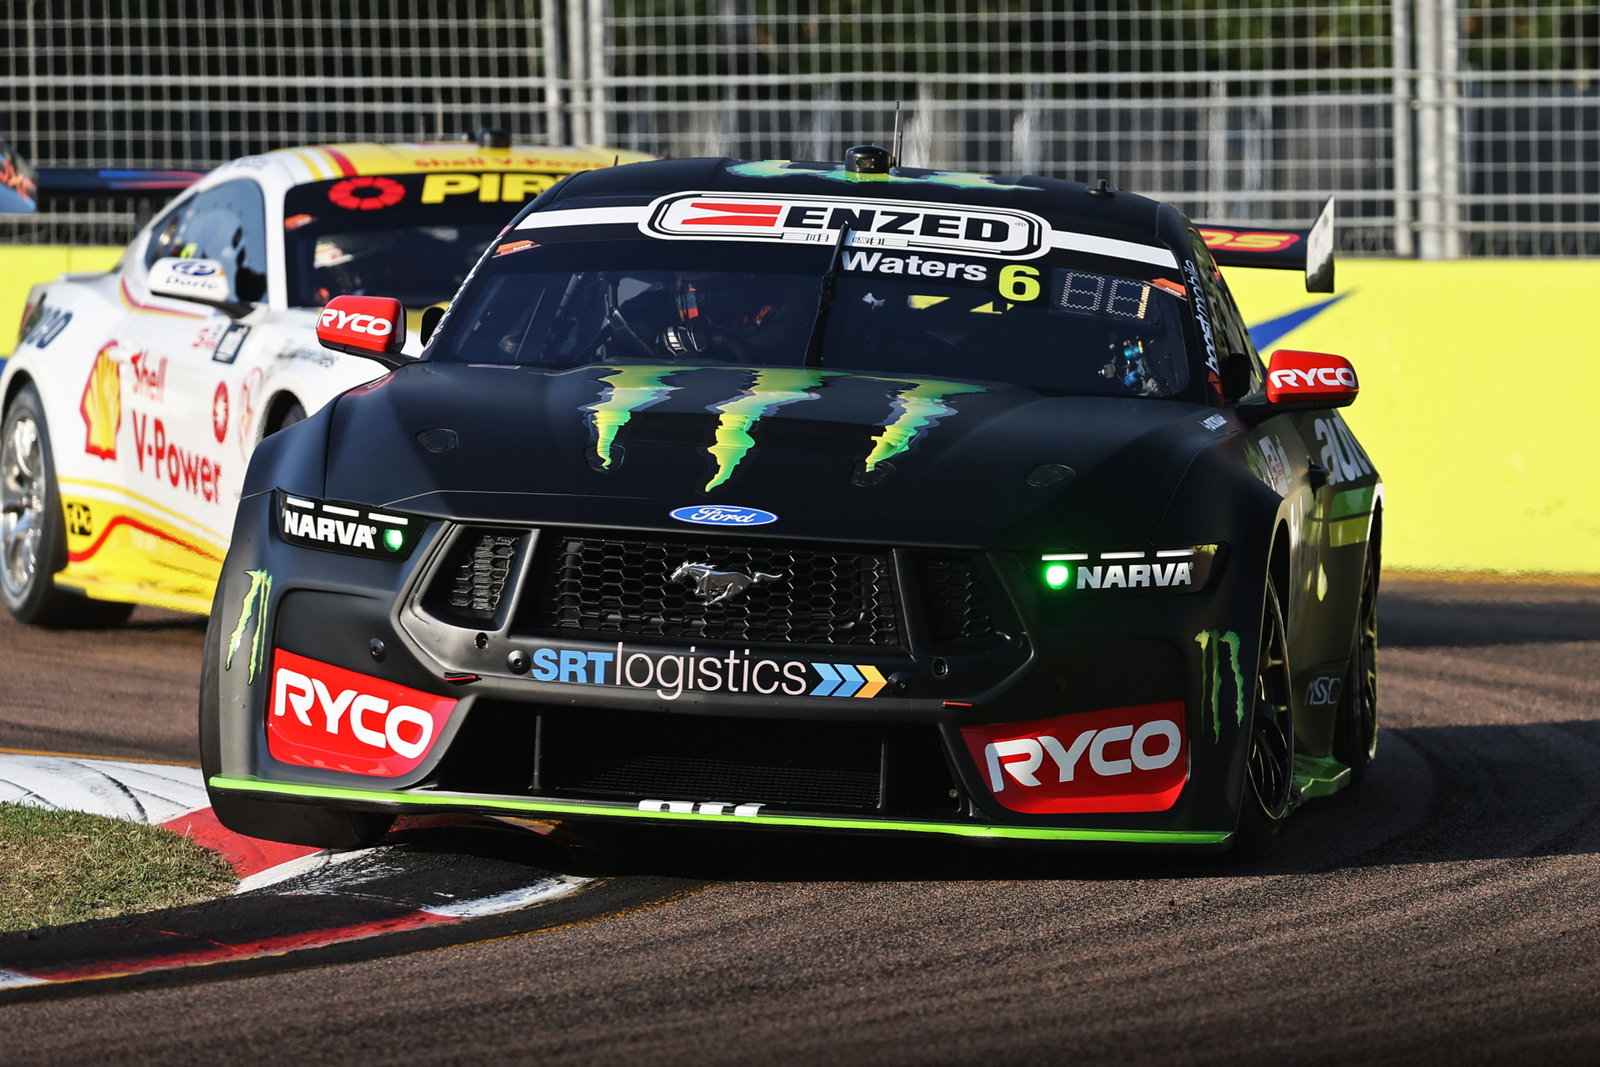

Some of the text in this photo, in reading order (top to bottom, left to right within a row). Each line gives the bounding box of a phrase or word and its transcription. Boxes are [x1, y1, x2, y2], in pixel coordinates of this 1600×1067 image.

[783, 205, 1010, 243] ENZED
[843, 251, 987, 282] Waters
[998, 264, 1040, 302] 6
[317, 308, 392, 336] RYCO
[131, 350, 167, 402] Shell
[1269, 367, 1356, 389] RYCO
[132, 409, 221, 504] V-Power
[284, 510, 376, 550] NARVA
[690, 507, 758, 523] Ford
[1076, 562, 1192, 589] NARVA
[274, 667, 434, 760] RYCO
[984, 719, 1182, 793] RYCO
